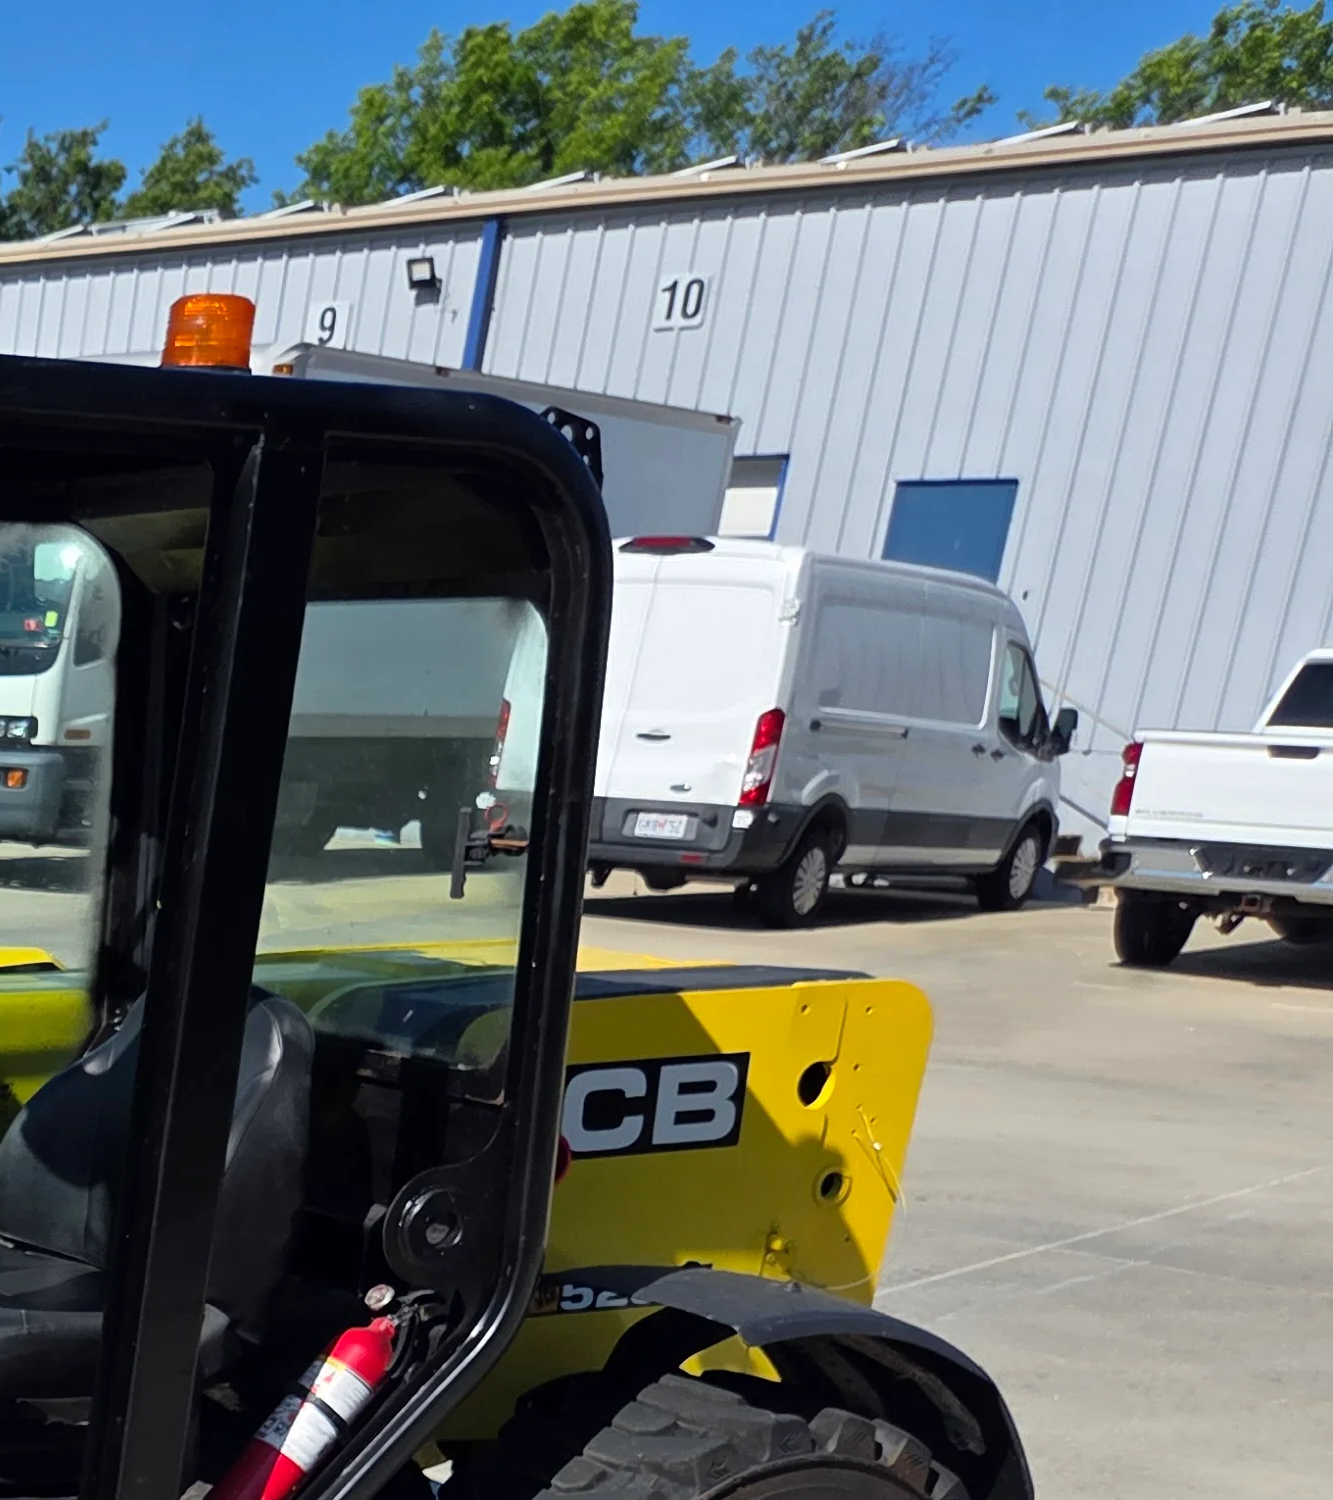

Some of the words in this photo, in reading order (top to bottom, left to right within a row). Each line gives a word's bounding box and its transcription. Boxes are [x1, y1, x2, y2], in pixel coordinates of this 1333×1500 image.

[661, 278, 706, 320] 10
[318, 306, 337, 345] 9
[561, 1060, 739, 1153] CB
[560, 1283, 650, 1311] 52
